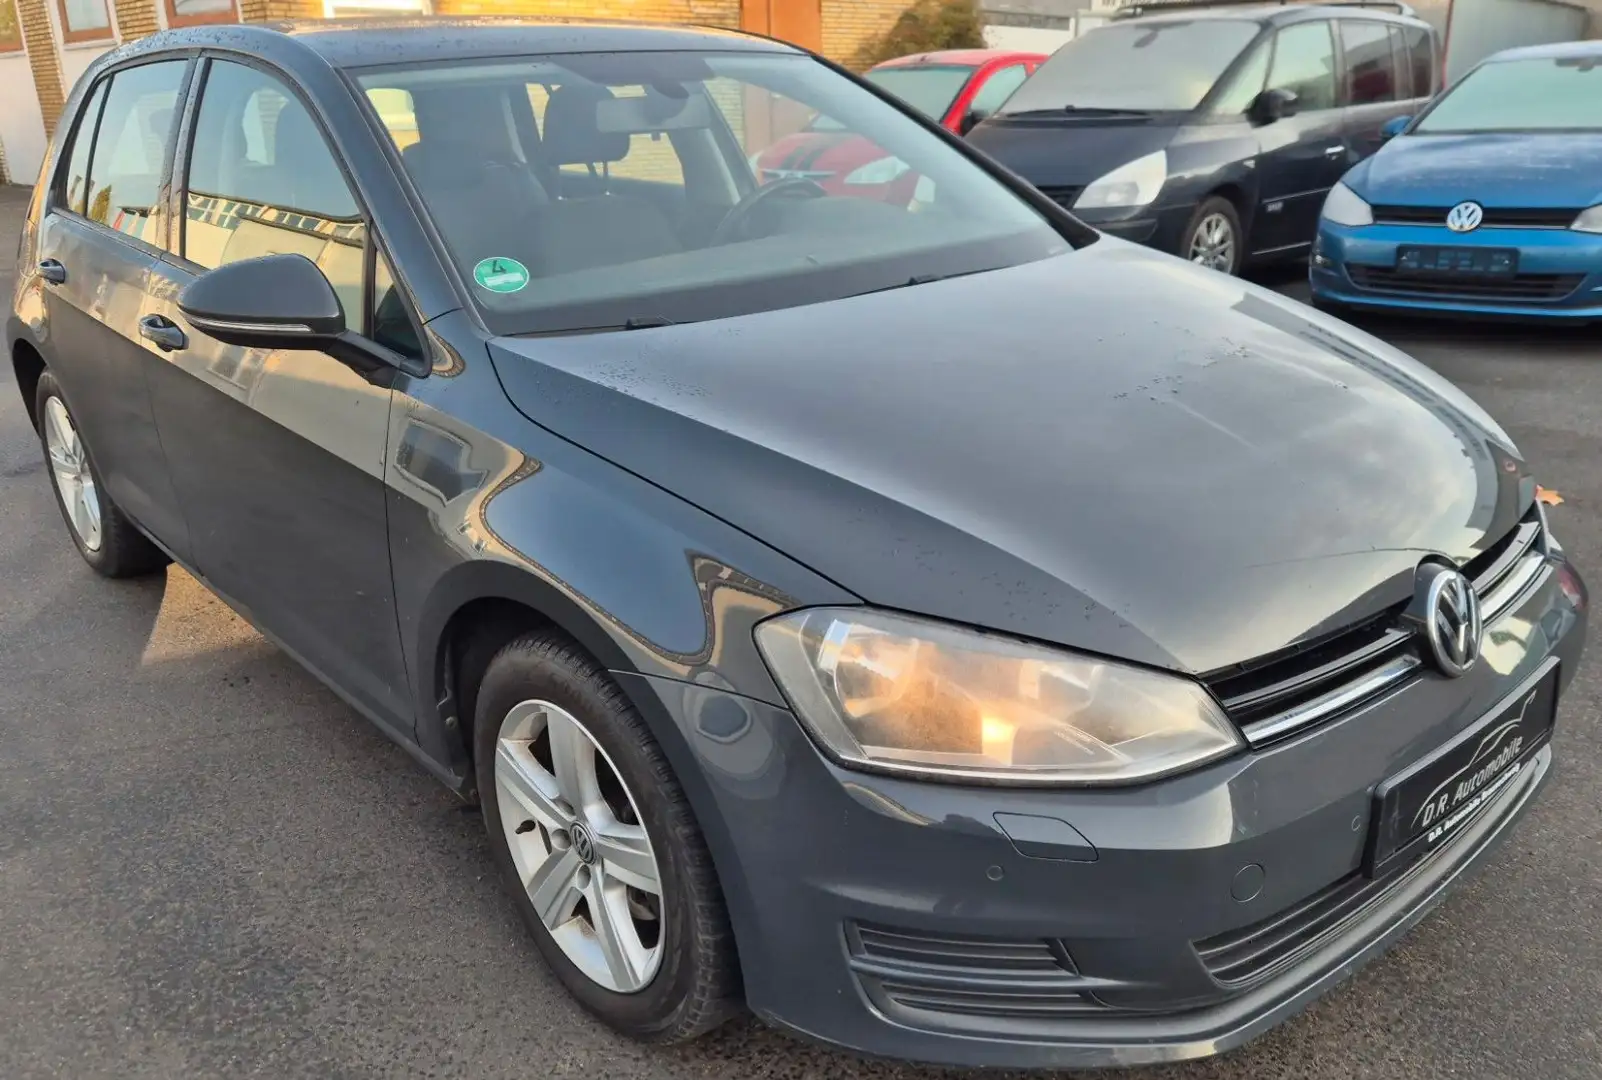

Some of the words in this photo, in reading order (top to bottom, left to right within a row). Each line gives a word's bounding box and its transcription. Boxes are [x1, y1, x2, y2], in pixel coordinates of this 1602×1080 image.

[1447, 201, 1483, 232] VW
[1427, 568, 1482, 678] VW
[1422, 793, 1449, 827] D.R.
[1451, 736, 1523, 806] Automobile
